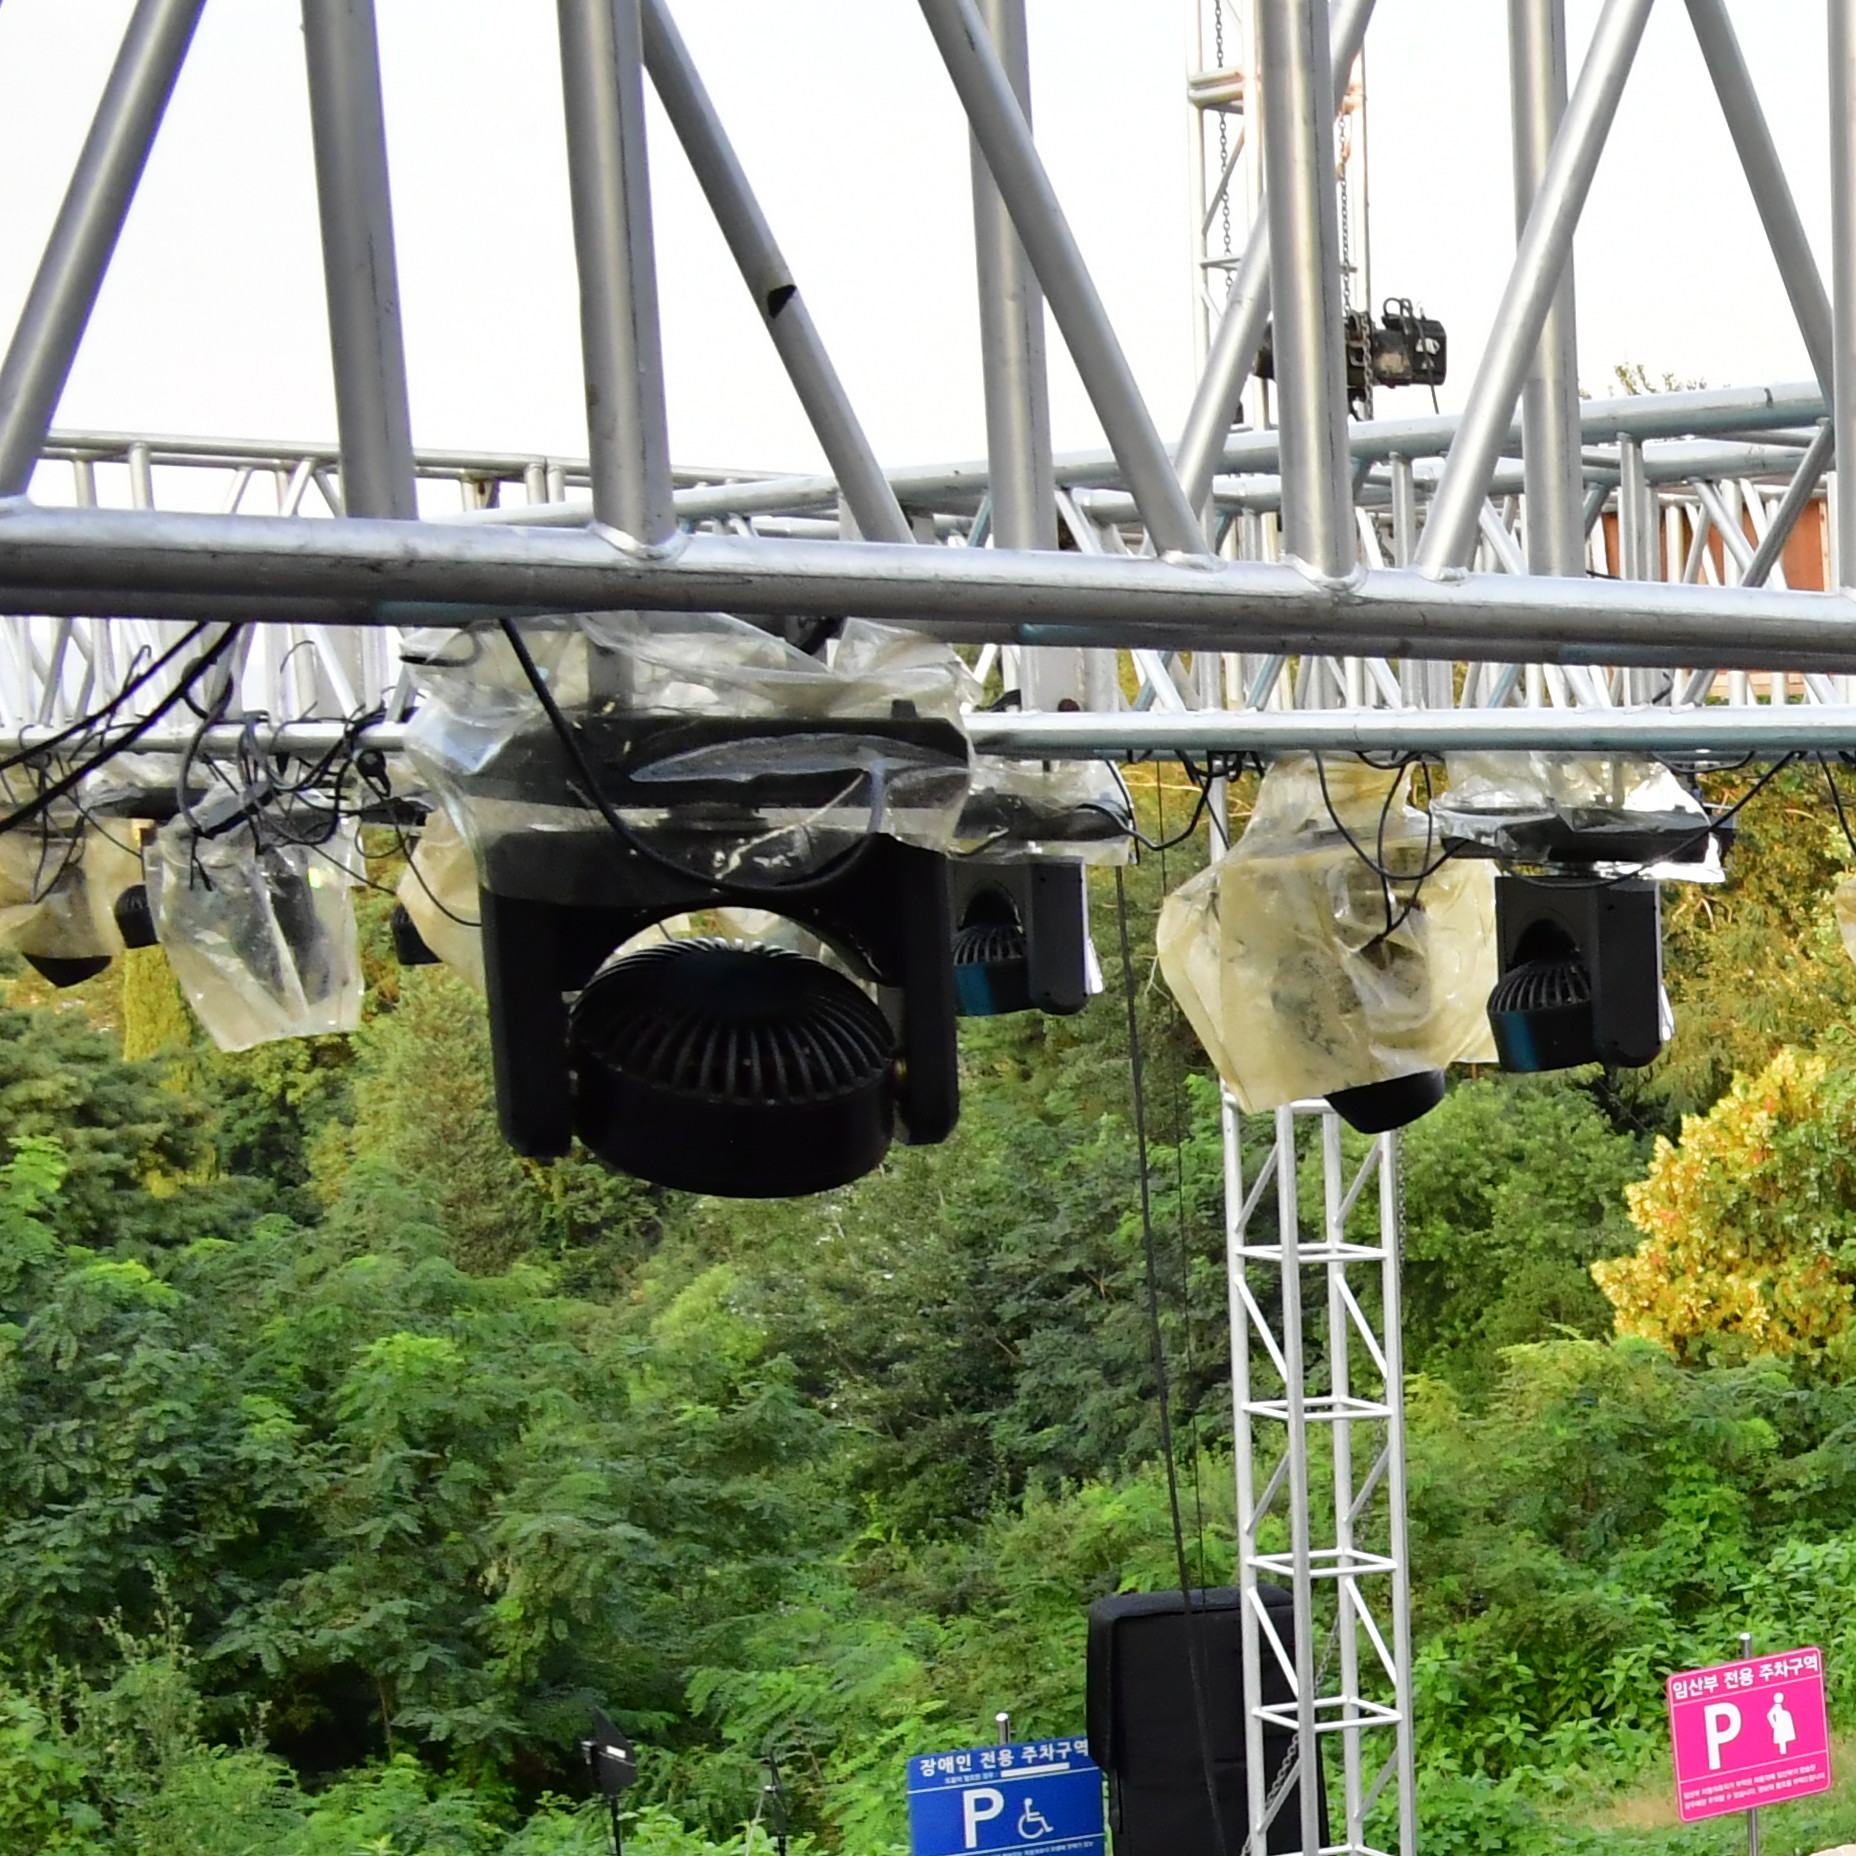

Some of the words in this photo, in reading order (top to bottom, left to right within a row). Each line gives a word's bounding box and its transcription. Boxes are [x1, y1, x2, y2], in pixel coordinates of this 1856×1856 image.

[1673, 1674, 1719, 1700] 임산부
[1723, 1667, 1754, 1689] 전용
[1758, 1654, 1818, 1682] 주차구역
[919, 1753, 973, 1778] 장애인
[979, 1748, 1015, 1770] 전용
[1020, 1738, 1089, 1765] 주차구역
[1704, 1702, 1742, 1771] P
[962, 1787, 1005, 1850] P
